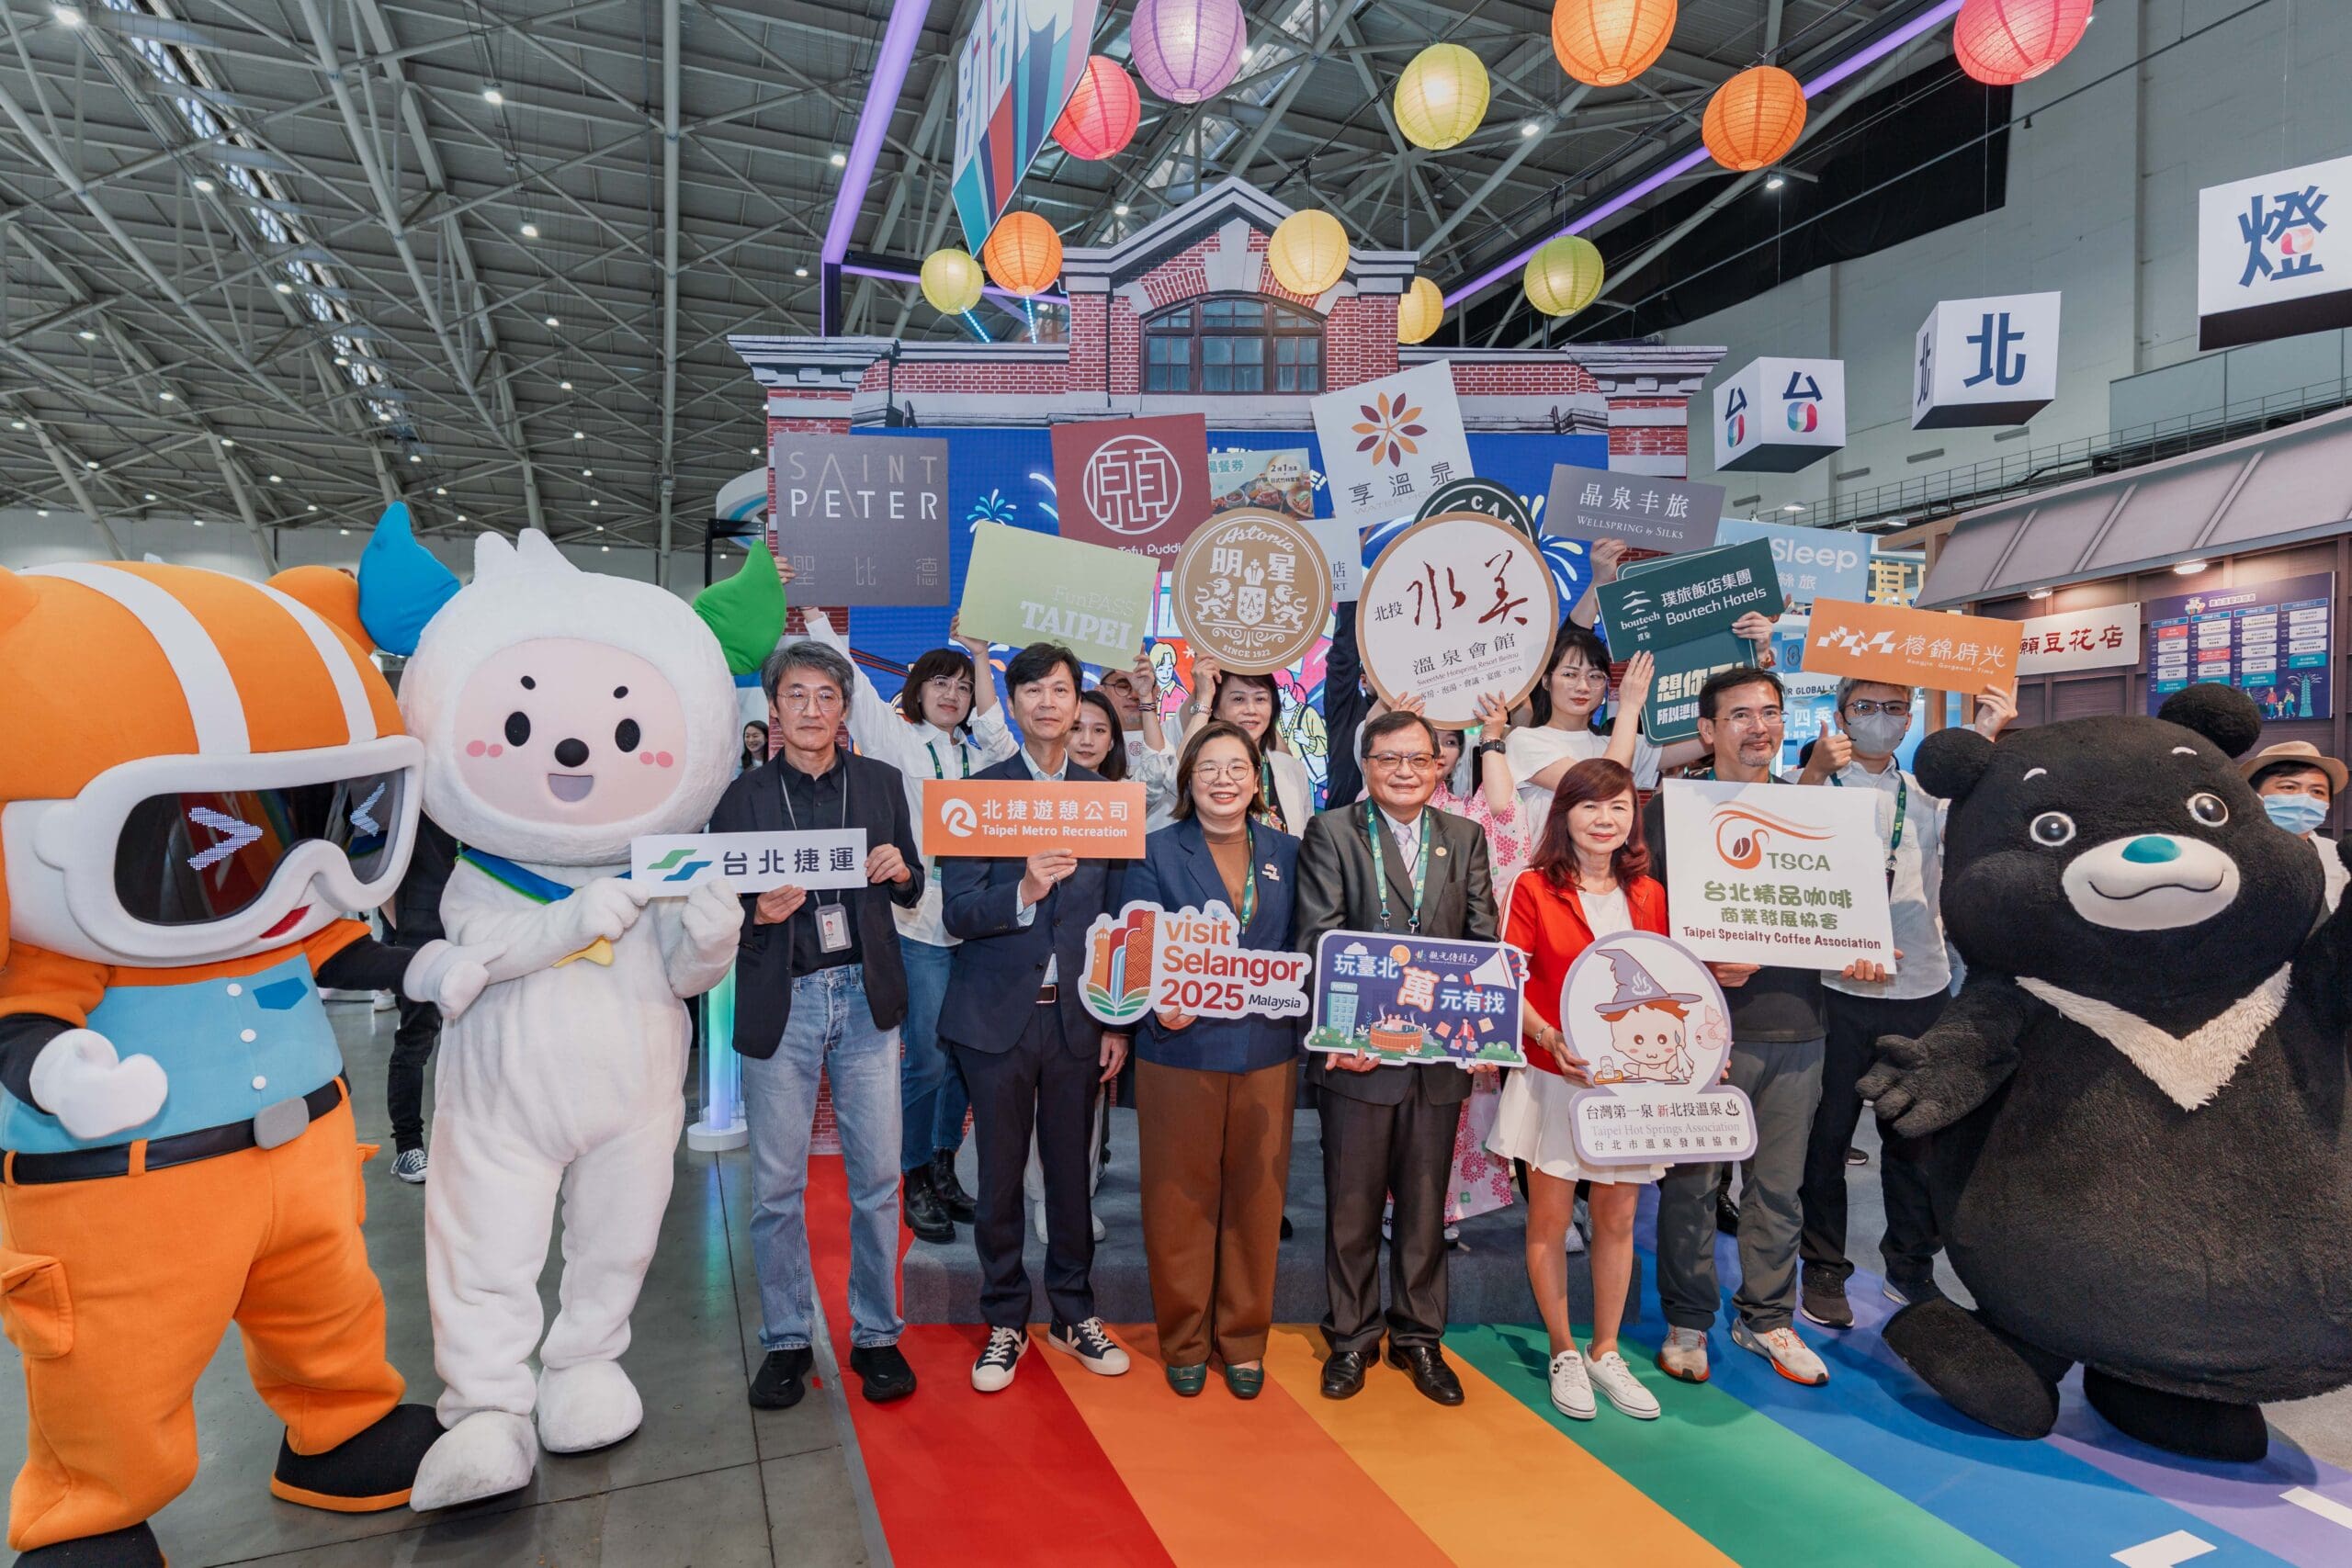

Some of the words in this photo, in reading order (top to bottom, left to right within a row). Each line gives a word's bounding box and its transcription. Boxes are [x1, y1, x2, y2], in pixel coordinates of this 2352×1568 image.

[2237, 185, 2329, 288] 燈
[1962, 312, 2027, 388] 北
[1782, 371, 1823, 434] 台
[1349, 460, 1456, 506] 享溫泉
[790, 488, 938, 520] PETER
[1470, 494, 1516, 525] CAF
[1579, 482, 1690, 520] 晶泉丰旅
[1216, 525, 1295, 553] Astoria
[1577, 514, 1645, 536] WELLSPRING
[1645, 526, 1654, 536] by
[1655, 526, 1684, 540] SILKS
[1147, 542, 1184, 555] Puddi
[1770, 536, 1859, 572] Sleep
[793, 555, 939, 586] 聖比德
[1209, 547, 1296, 583] 明星
[1051, 584, 1137, 617] FunPASS
[1661, 568, 1753, 609] 璞旅飯店集團
[1374, 601, 1404, 622] 北投
[1620, 611, 1661, 631] boutech
[1665, 599, 1722, 626] Boutech
[1723, 586, 1768, 610] Hotels
[1020, 600, 1133, 650] TAIPEI
[1222, 644, 1250, 659] SINCE
[1252, 649, 1272, 659] 1922
[1411, 631, 1516, 676] 溫泉會館
[1896, 634, 2007, 668] 榕錦時光
[1796, 684, 1826, 695] GLOBAL
[981, 798, 1129, 822] 北捷遊憩公司
[981, 823, 1018, 838] Taipei
[1022, 825, 1057, 837] Metro
[1062, 825, 1128, 838] Recreation
[722, 846, 855, 876] 台北捷運
[1766, 852, 1831, 872] TSCA
[1703, 879, 1853, 909] 台北精品咖啡
[1720, 906, 1838, 931] 商業發展協會
[1682, 926, 1716, 940] Taipei
[1718, 928, 1772, 944] Specialty
[1774, 931, 1812, 945] Coffee
[1815, 934, 1882, 950] Association
[1161, 944, 1304, 987] Selangor
[1159, 978, 1245, 1011] 2025
[1248, 993, 1302, 1011] Malaysia
[1333, 953, 1399, 980] 玩臺北
[1396, 966, 1441, 1012] 萬
[1440, 987, 1507, 1015] 元有找
[1586, 1103, 1654, 1120] 台灣第一泉
[1657, 1101, 1723, 1118] 新北投溫泉
[1591, 1123, 1623, 1138] Taipei
[1624, 1124, 1644, 1135] Hot
[1645, 1123, 1683, 1137] Springs
[1684, 1122, 1740, 1134] Association
[1594, 1135, 1738, 1152] 台北市溫泉發展協會
